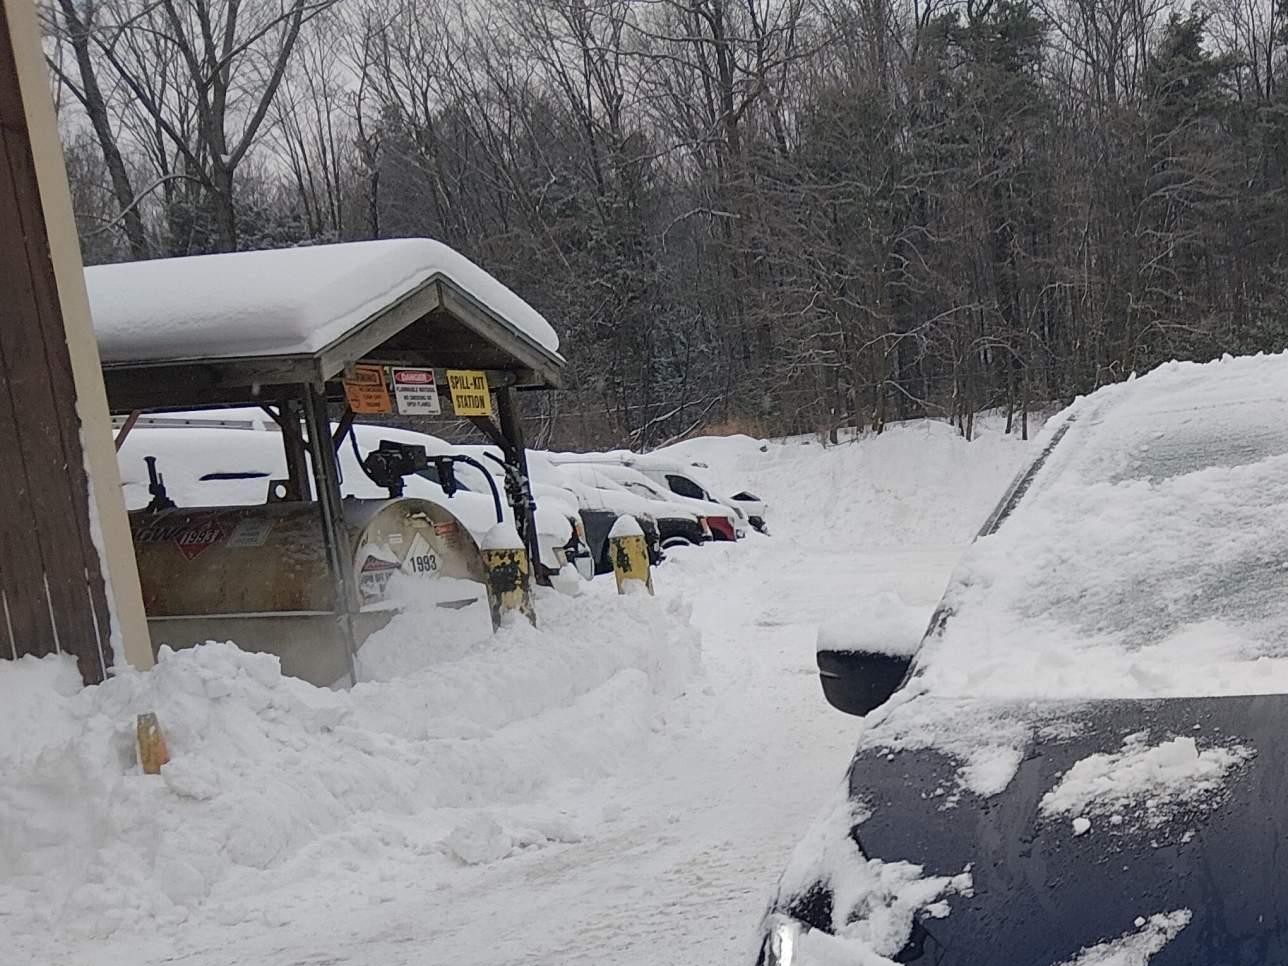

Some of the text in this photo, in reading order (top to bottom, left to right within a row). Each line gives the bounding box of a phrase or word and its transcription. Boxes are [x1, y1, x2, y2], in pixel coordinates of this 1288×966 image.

[450, 375, 485, 390] SPILL-KIT
[456, 394, 485, 409] STATION
[410, 554, 437, 573] 1993
